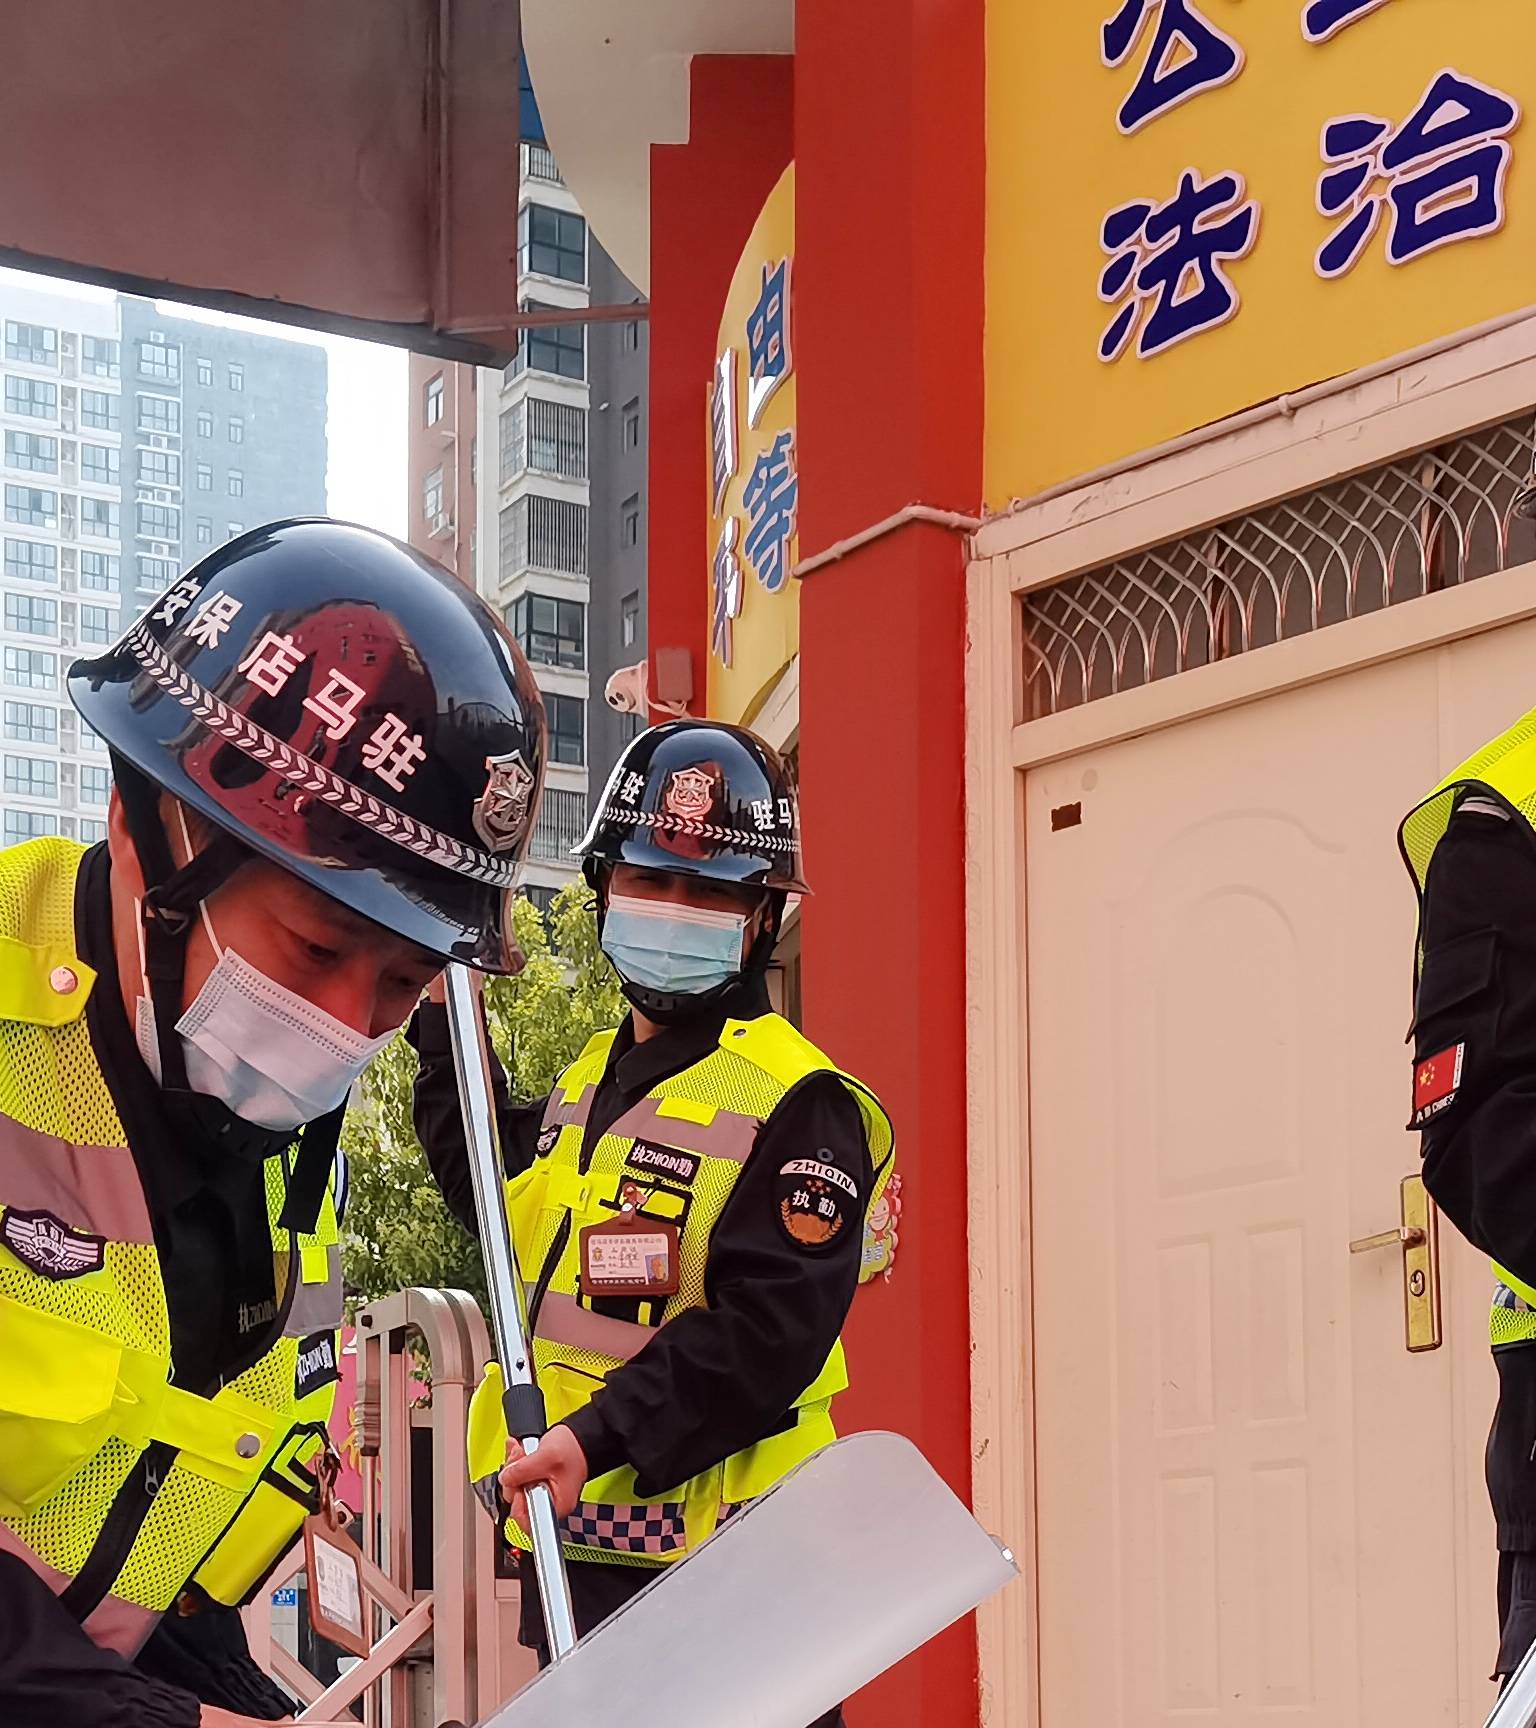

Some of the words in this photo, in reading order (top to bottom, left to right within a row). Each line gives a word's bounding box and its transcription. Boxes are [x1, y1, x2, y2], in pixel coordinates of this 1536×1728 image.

[1097, 67, 1521, 363] 法治
[792, 1162, 852, 1190] ZHIQIN
[792, 1189, 836, 1218] 执勤
